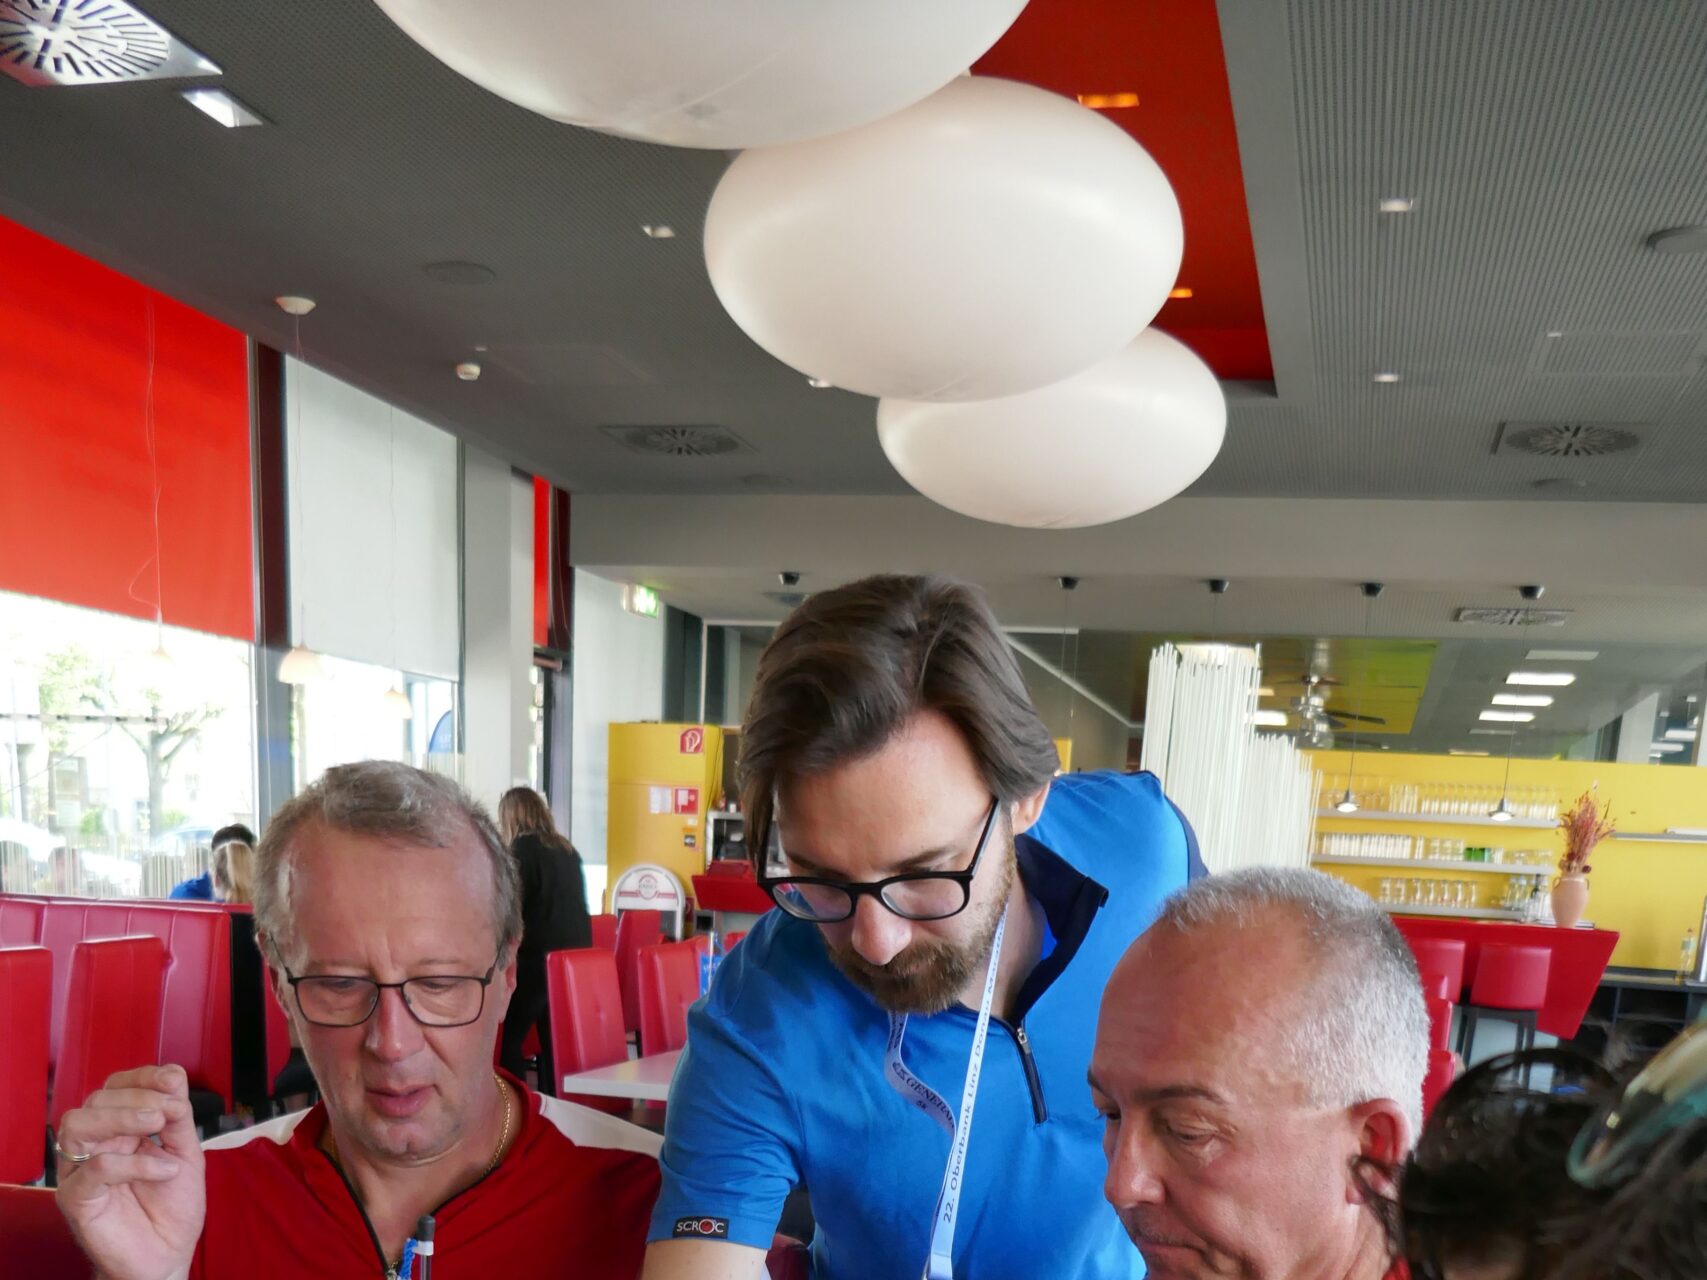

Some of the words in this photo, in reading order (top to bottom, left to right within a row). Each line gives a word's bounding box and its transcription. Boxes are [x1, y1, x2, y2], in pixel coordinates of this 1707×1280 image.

[944, 1198, 956, 1224] 22.
[950, 1104, 973, 1191] Oberbank
[967, 1064, 979, 1099] Linz
[974, 1000, 990, 1058] Donau
